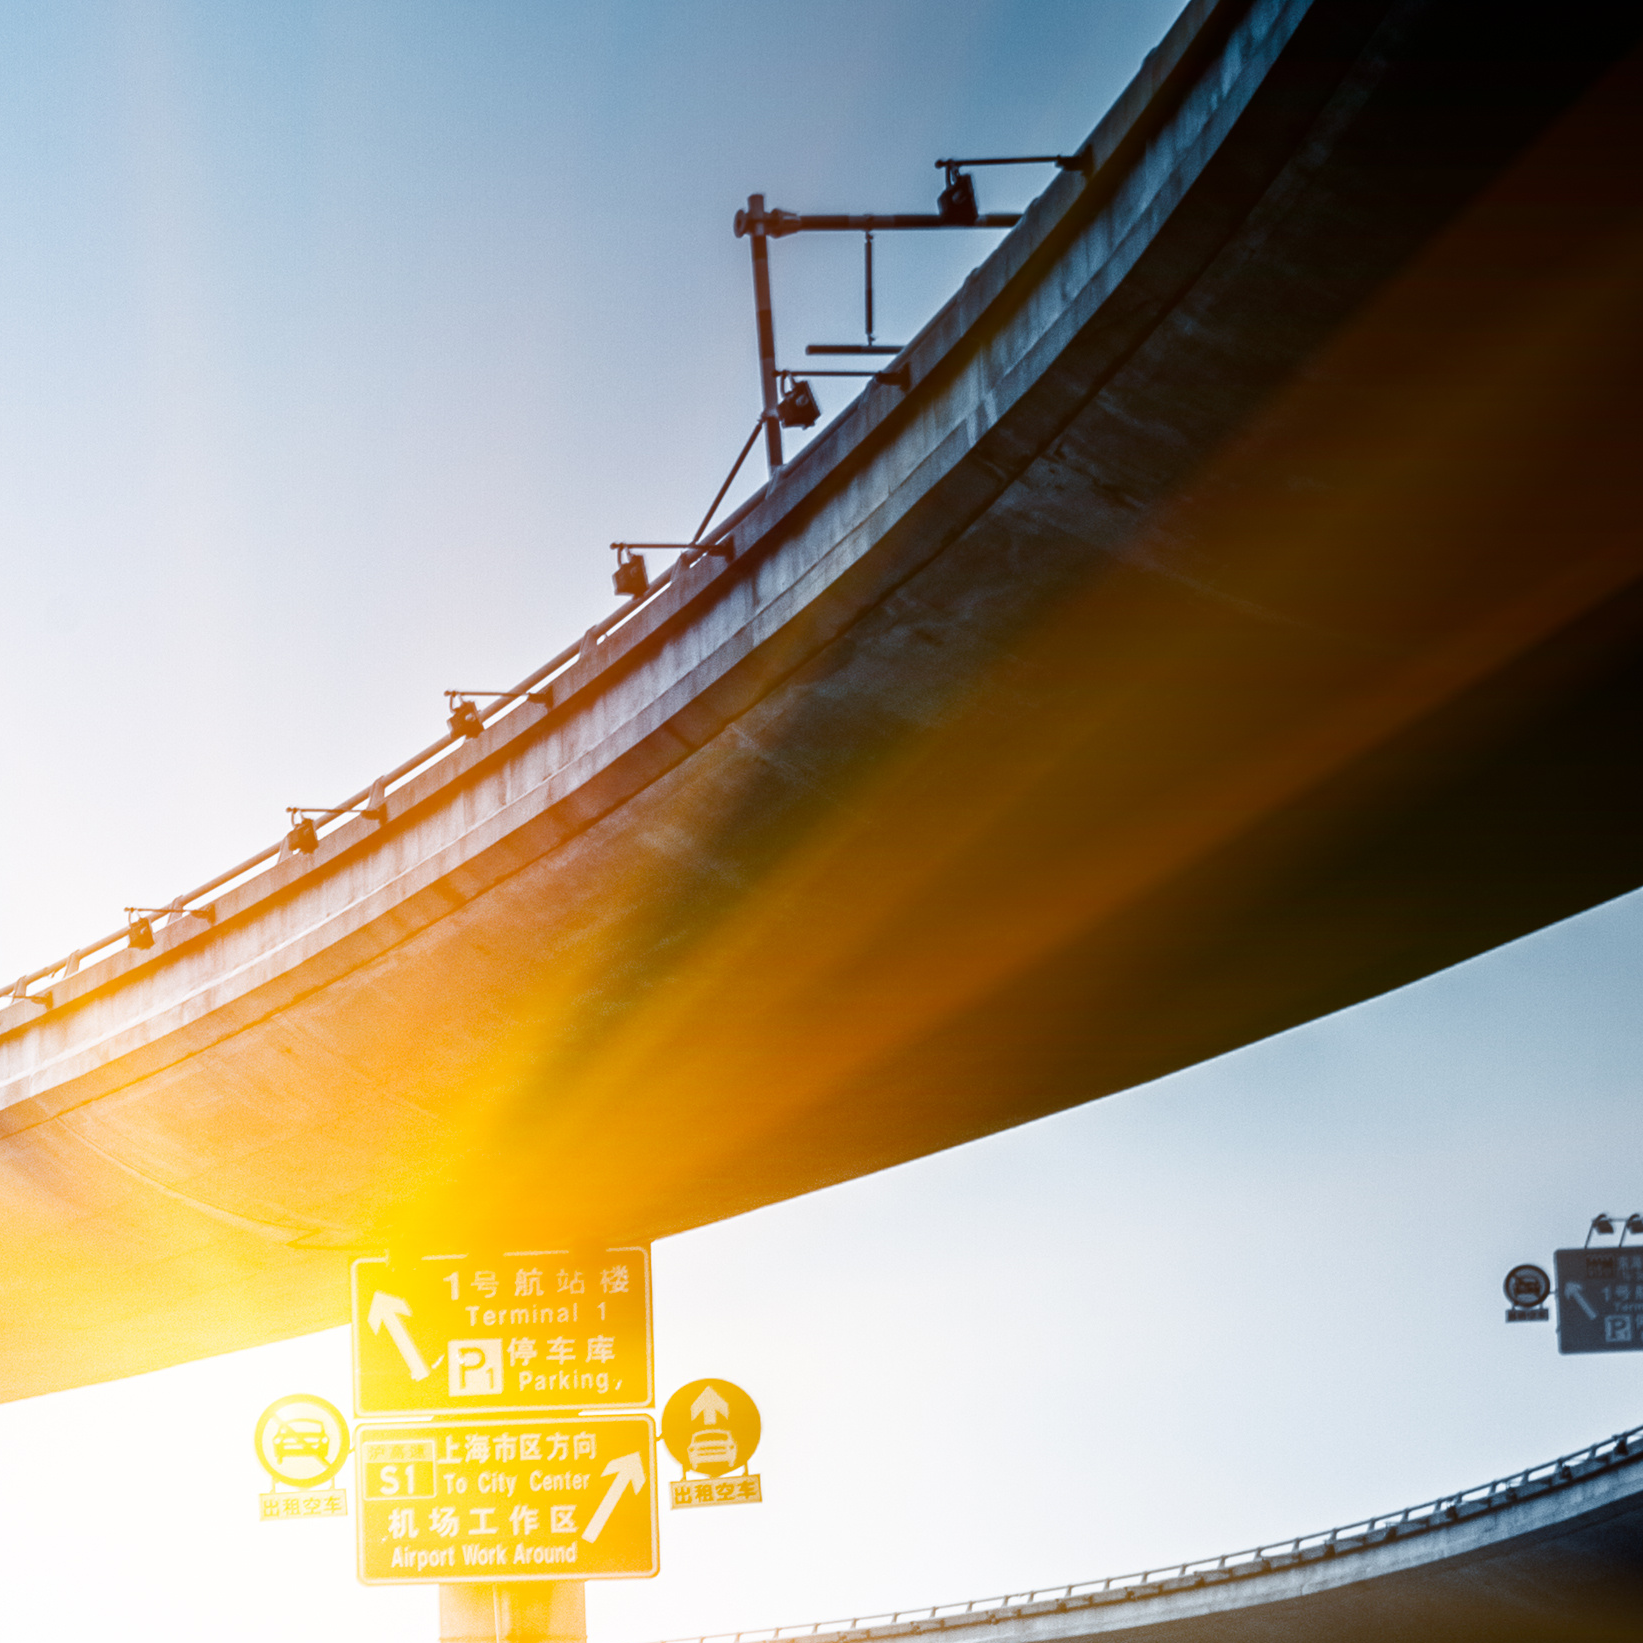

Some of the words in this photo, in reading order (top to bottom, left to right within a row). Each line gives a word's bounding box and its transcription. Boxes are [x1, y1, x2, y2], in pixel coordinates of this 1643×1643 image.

[443, 1265, 630, 1301] 1号航站楼
[465, 1303, 579, 1327] Terminal
[597, 1302, 607, 1322] 1
[507, 1335, 616, 1368] 停车库
[458, 1346, 496, 1391] P1
[518, 1369, 610, 1394] Parking
[437, 1430, 598, 1465] 上海市区方向
[379, 1464, 416, 1495] S1
[443, 1472, 468, 1495] To
[477, 1469, 518, 1498] City
[529, 1469, 592, 1492] Center
[674, 1480, 757, 1505] 出租空车
[263, 1495, 342, 1517] 出租空车
[387, 1504, 580, 1539] 机场工作区
[391, 1544, 456, 1572] Airport
[462, 1543, 508, 1566] Work
[513, 1541, 578, 1565] Around
